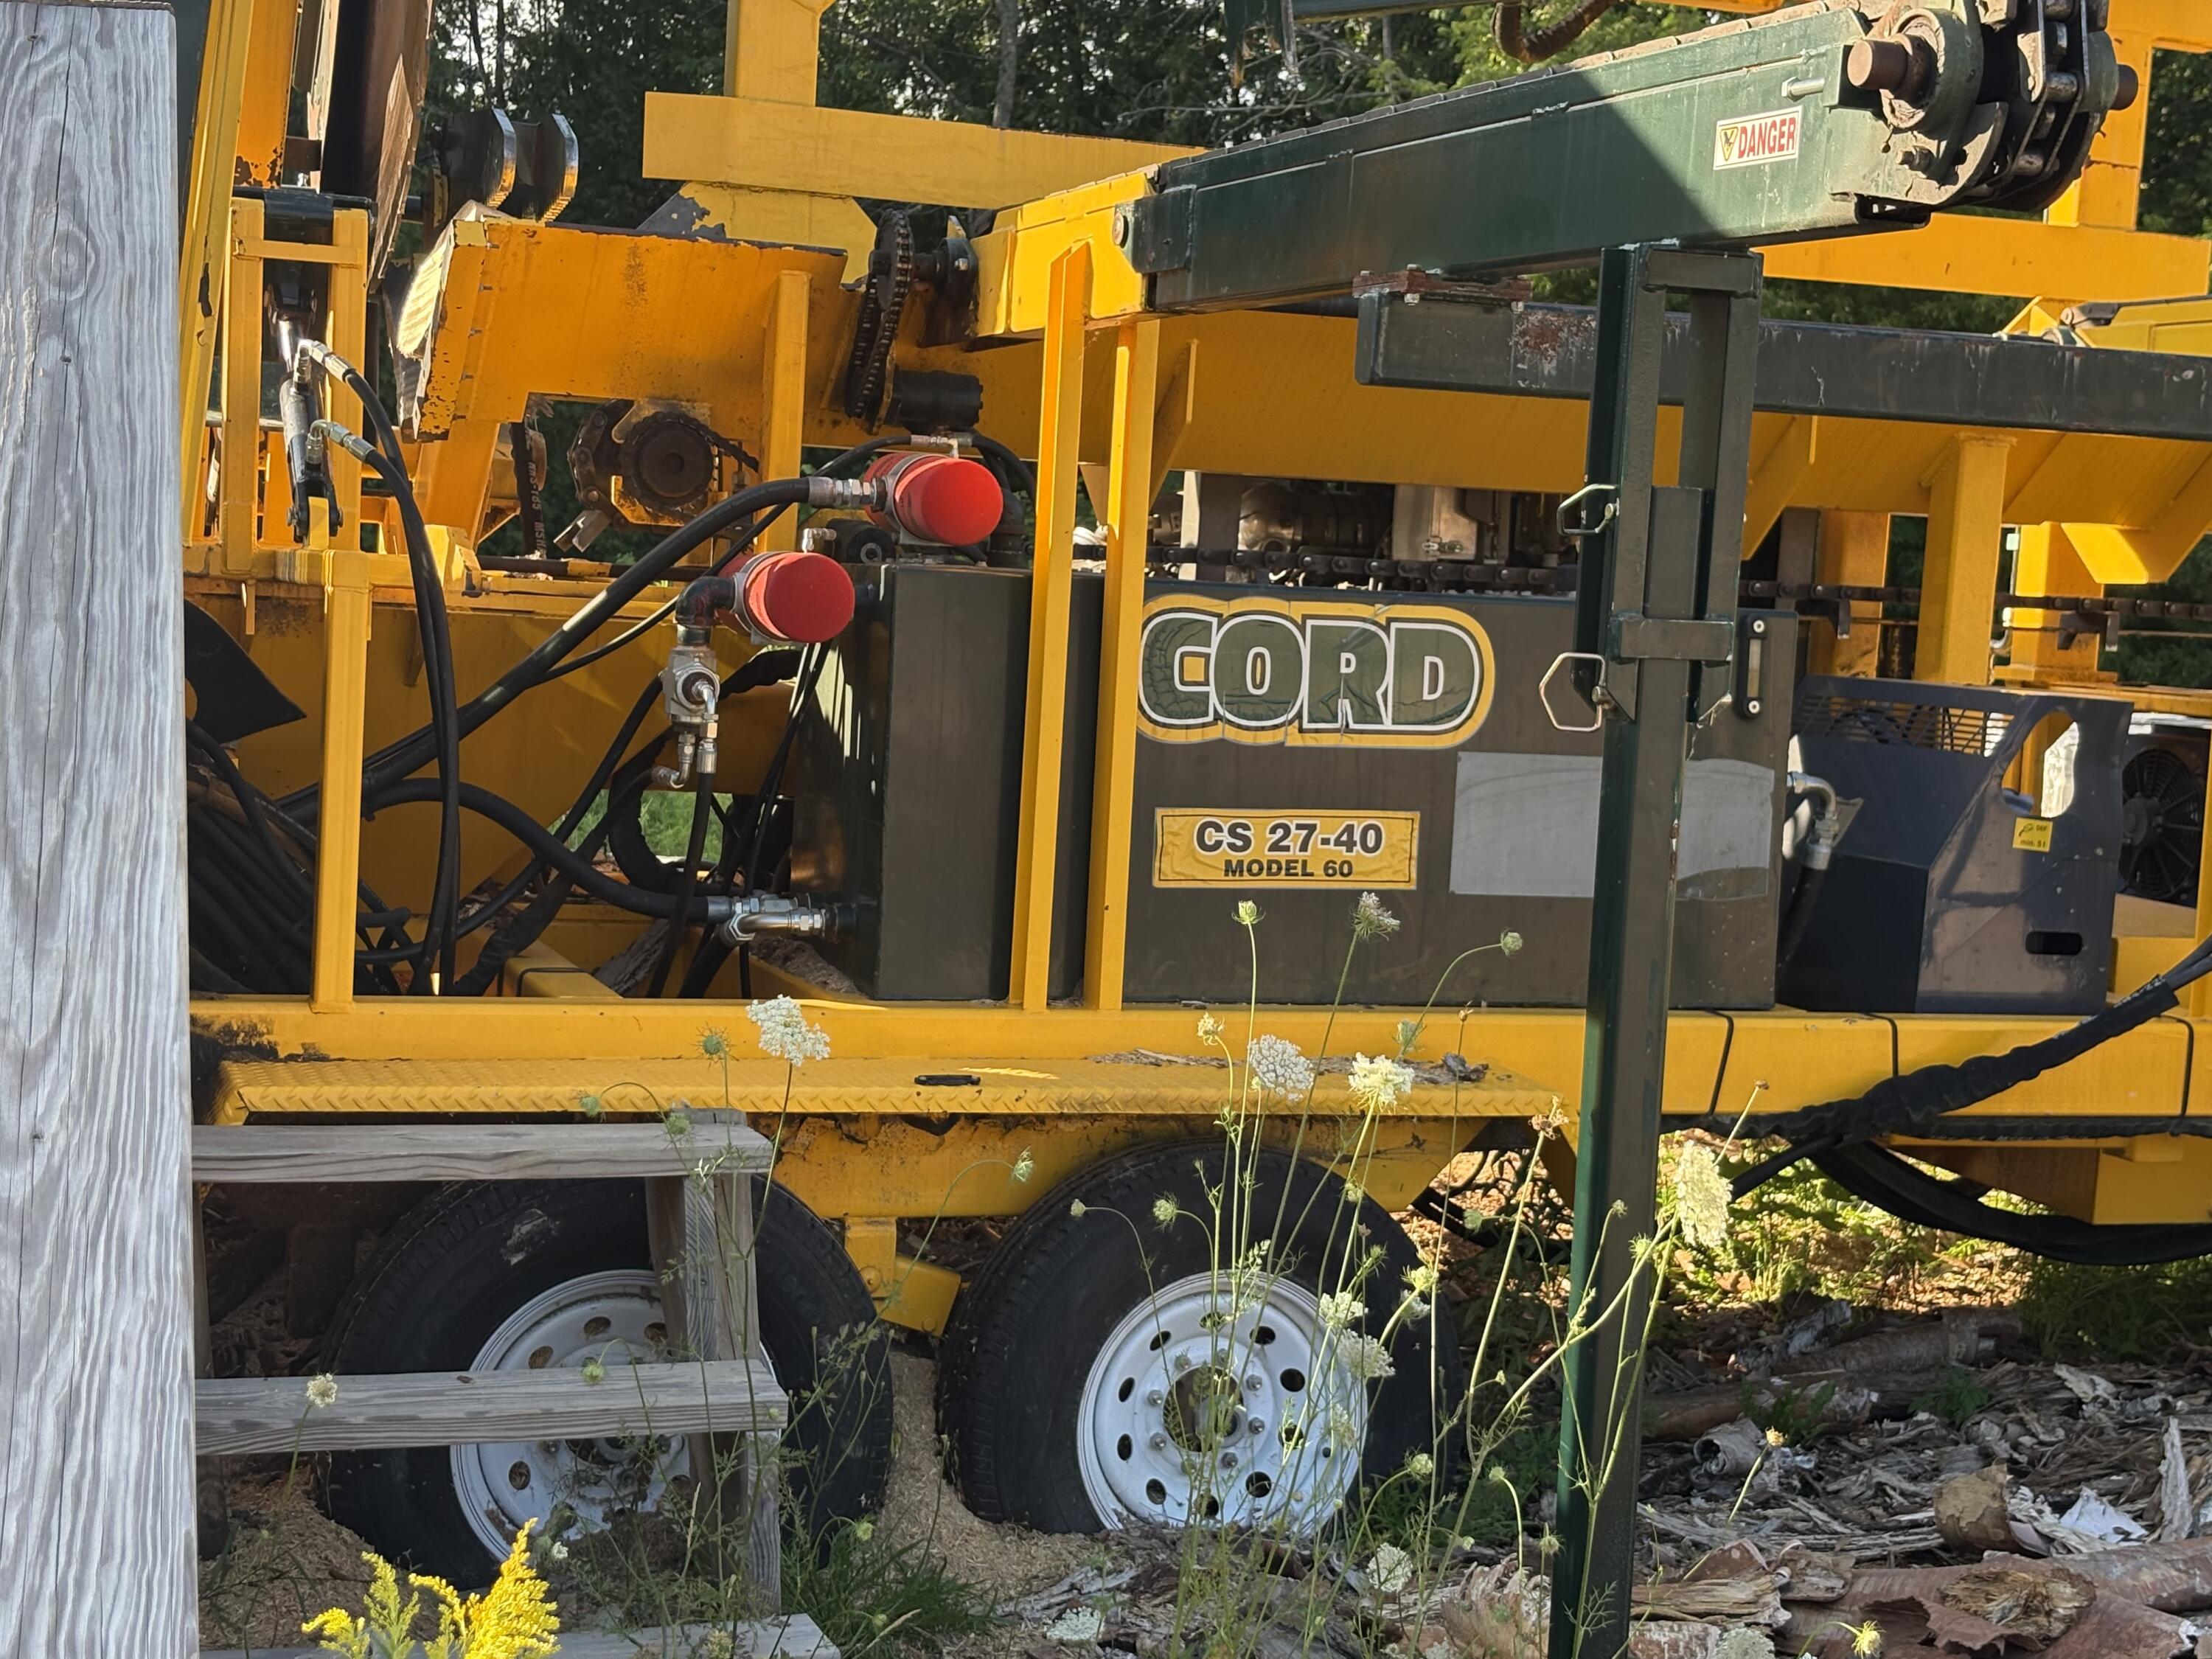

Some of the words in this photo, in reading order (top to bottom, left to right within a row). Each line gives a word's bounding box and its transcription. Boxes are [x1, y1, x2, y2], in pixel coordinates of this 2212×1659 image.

[1738, 116, 1797, 159] DANGER
[1138, 613, 1479, 730] CORD
[1195, 820, 1253, 853] CS
[1266, 821, 1383, 855] 27-40
[1224, 859, 1314, 877] MODEL
[1323, 859, 1353, 878] 60
